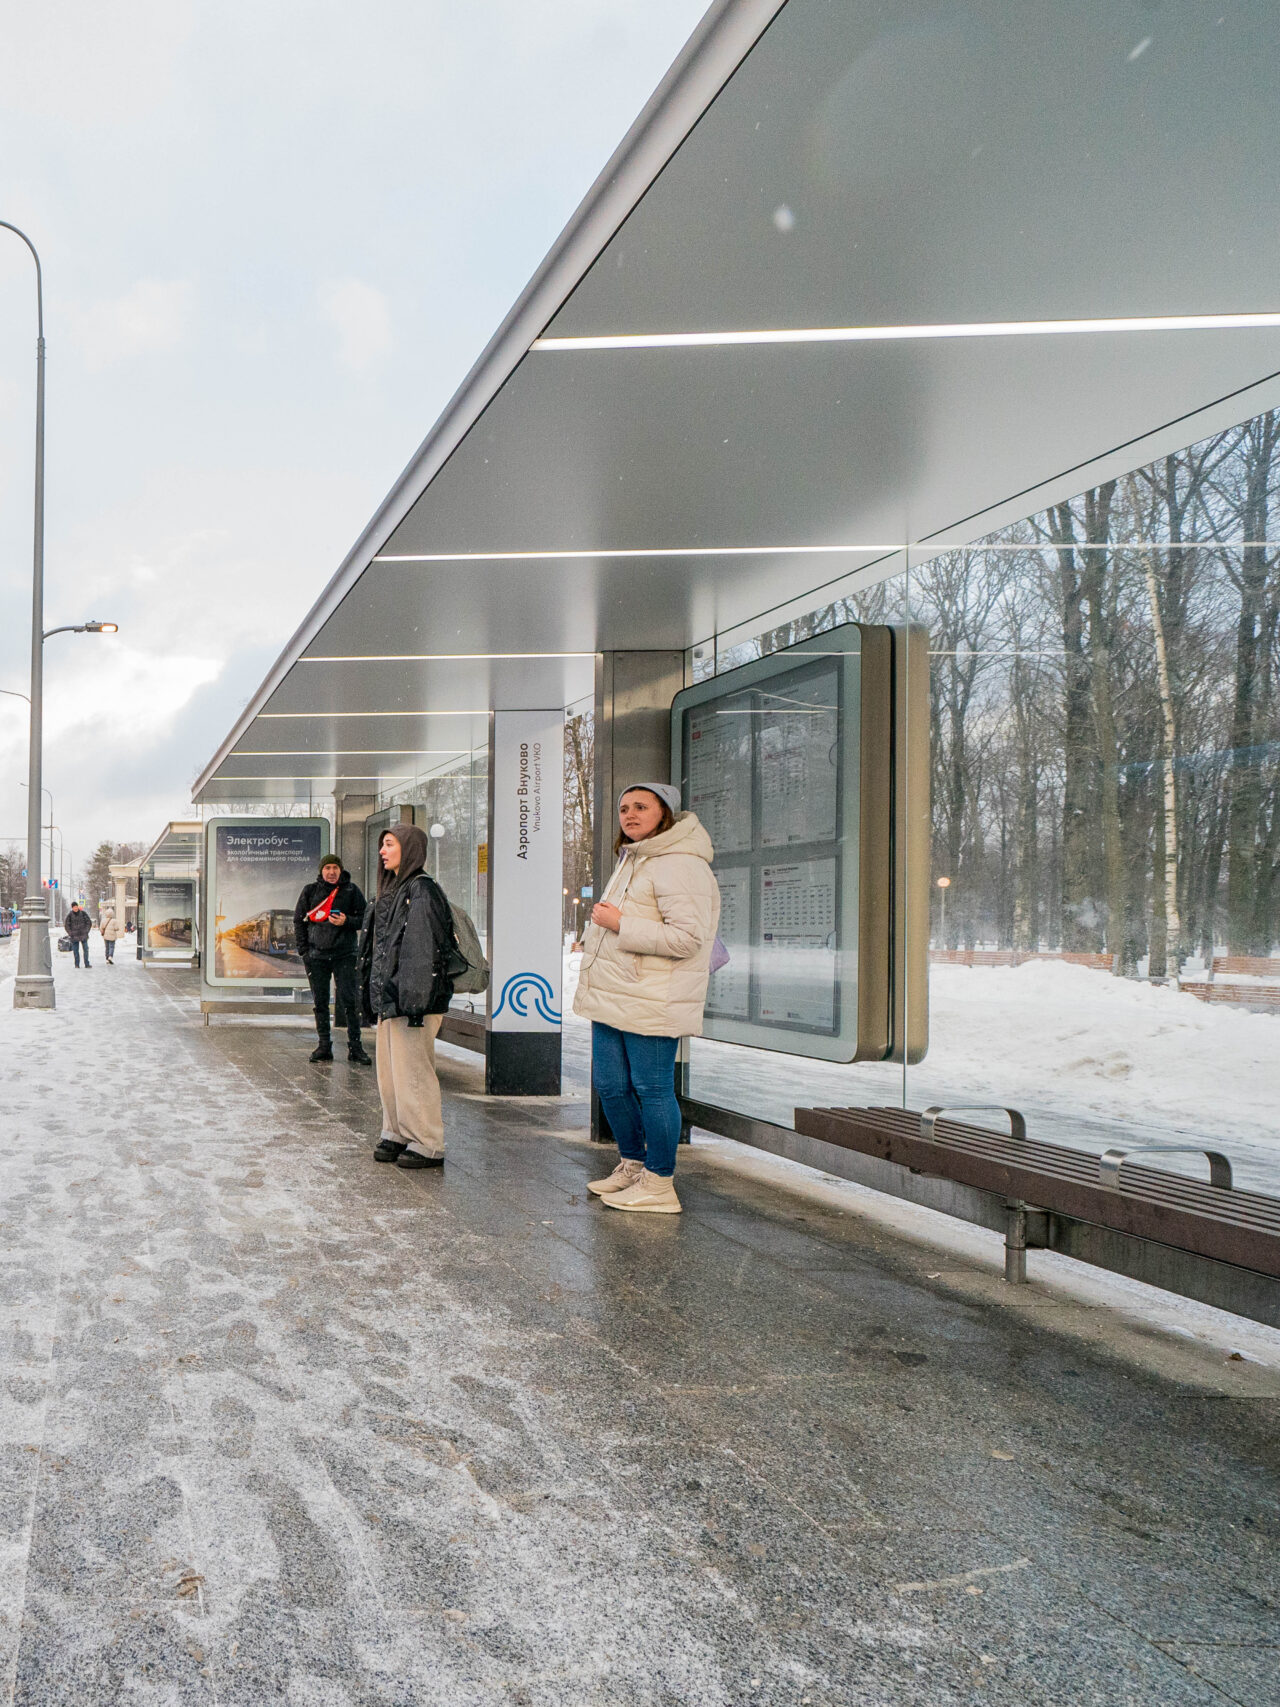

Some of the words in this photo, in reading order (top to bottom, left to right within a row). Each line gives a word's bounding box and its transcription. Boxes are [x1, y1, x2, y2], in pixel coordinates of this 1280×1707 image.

[533, 742, 541, 762] VKO
[517, 743, 531, 796] Внуково
[533, 763, 542, 794] Airport
[517, 799, 530, 860] Аэропорт
[533, 796, 541, 832] Vnukovo
[226, 835, 289, 847] Электробус
